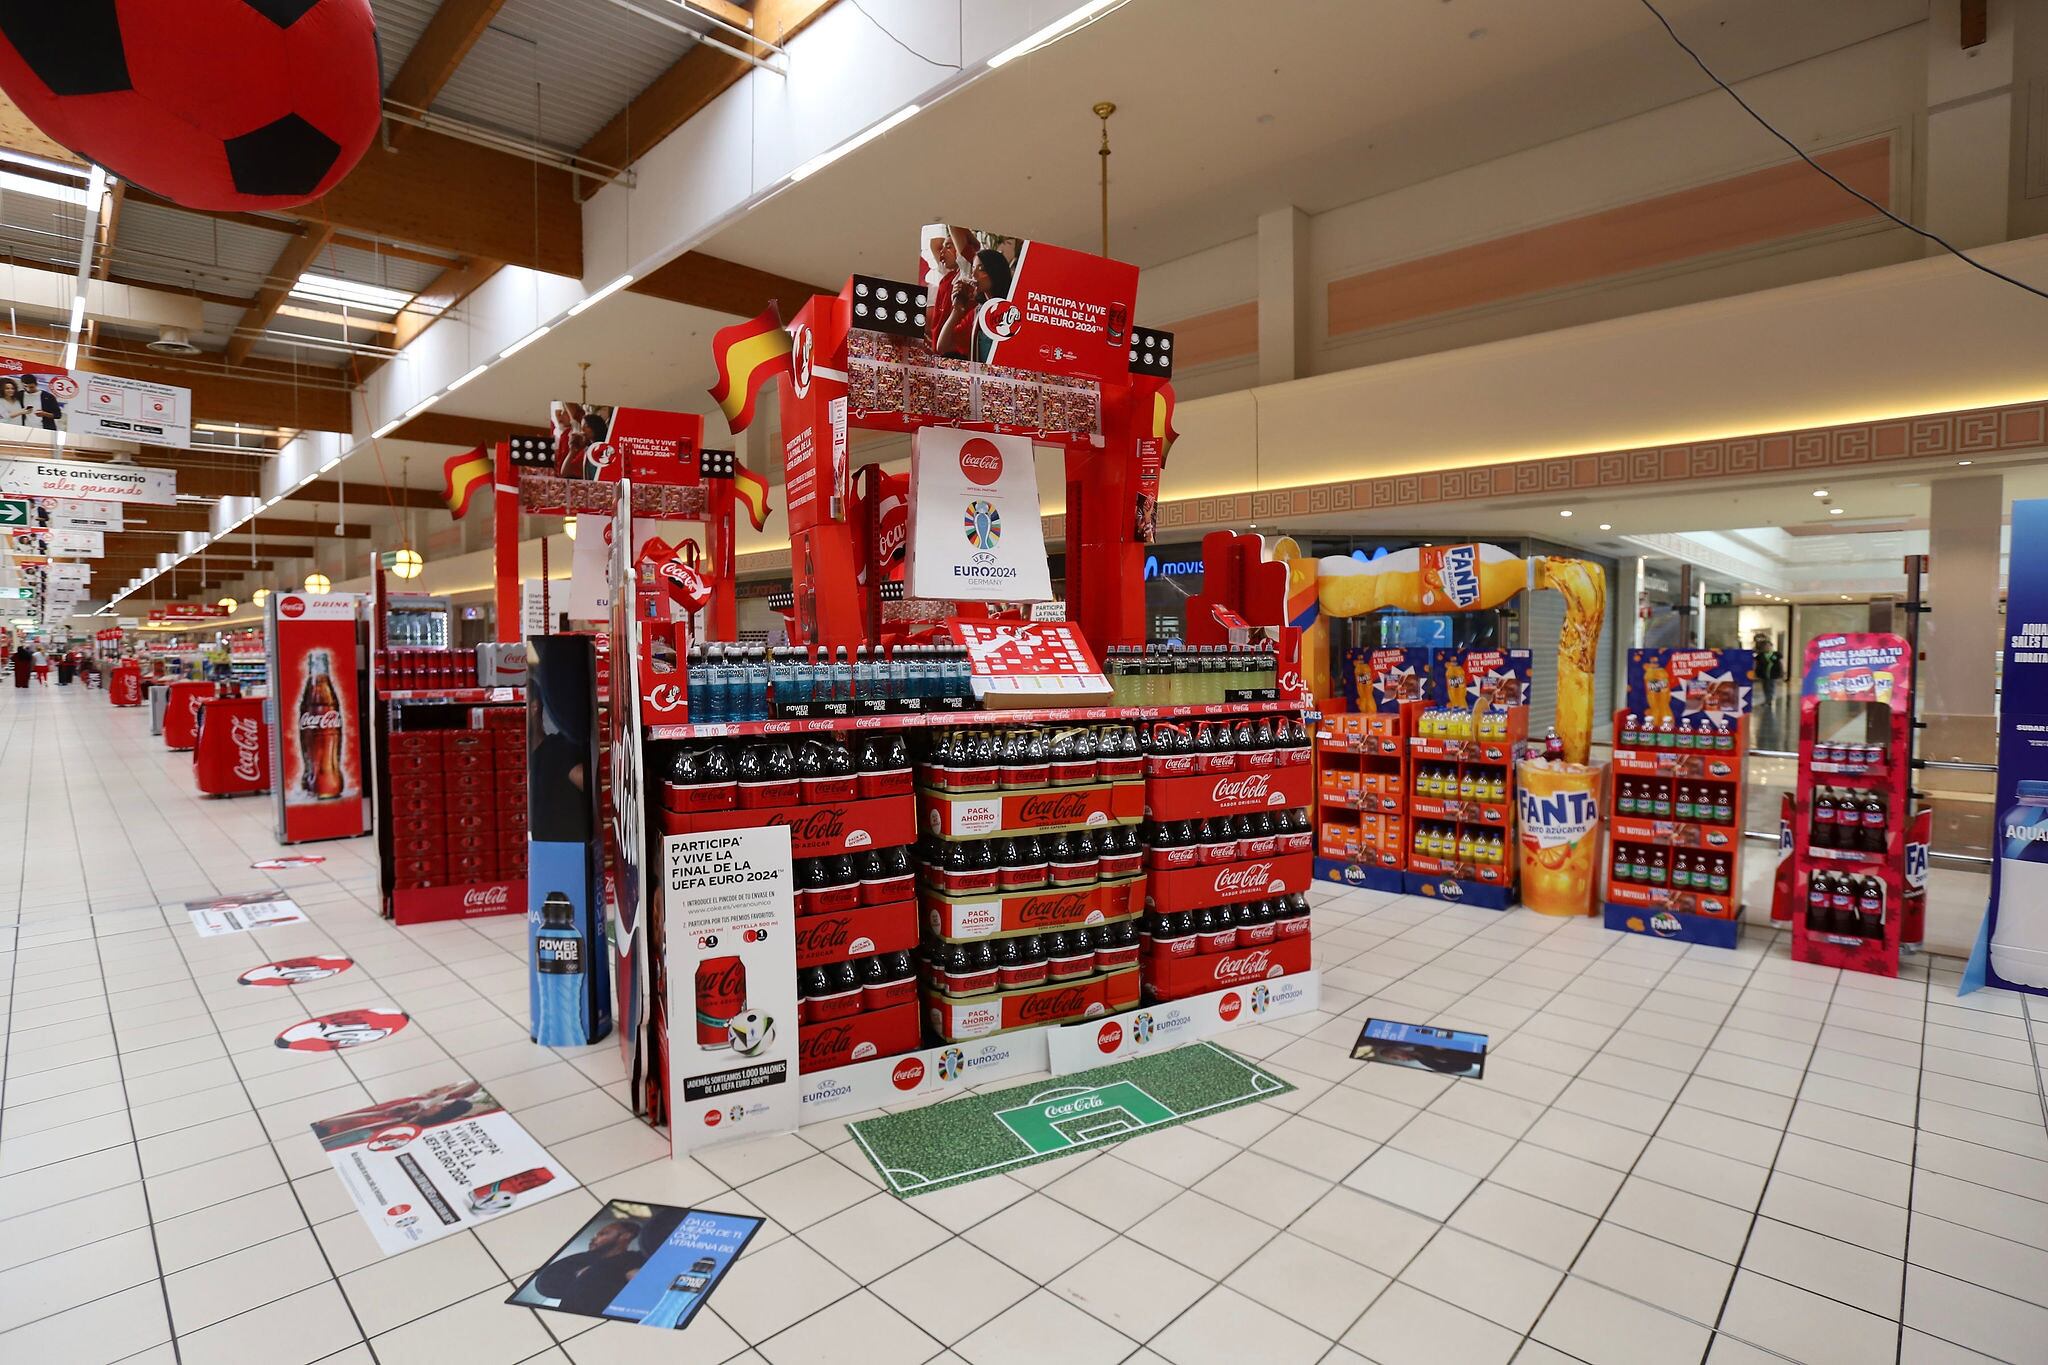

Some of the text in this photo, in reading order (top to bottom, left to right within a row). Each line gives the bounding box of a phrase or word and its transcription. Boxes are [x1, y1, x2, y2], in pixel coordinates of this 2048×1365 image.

[1028, 292, 1106, 315] PARTICIPA Y VIVE
[1027, 302, 1096, 323] LA FINAL DE LA
[1026, 313, 1049, 324] UEFA
[1050, 317, 1075, 329] EURO
[619, 436, 654, 444] PARTICIPA
[962, 453, 999, 470] Coca-Cola
[37, 465, 147, 484] Este aniversario
[43, 478, 143, 498] sales ganando
[973, 554, 995, 564] UEFA
[968, 578, 1003, 586] GERMANY
[1451, 546, 1478, 606] FANTA
[1433, 620, 1446, 639] 2
[1818, 637, 1846, 648] NUEVO
[2012, 636, 2040, 648] SALES
[1820, 651, 1847, 659] AÑADE
[1848, 649, 1878, 658] SABOR
[1820, 659, 1847, 667] SNACK
[1869, 656, 1897, 664] FANTA
[300, 711, 342, 731] Coca-Cola
[2016, 724, 2045, 732] SUDAR
[231, 716, 260, 781] Coca-Cola
[1486, 750, 1502, 758] FANTA
[1165, 758, 1191, 769] Coca-Cola
[1211, 755, 1235, 766] Coca-Cola
[1250, 753, 1274, 764] Coca-Cola
[1213, 774, 1272, 802] Coca-Cola
[967, 807, 989, 815] PACK
[1020, 792, 1089, 822] Coca-Cola
[1519, 788, 1597, 827] FANTA
[961, 814, 995, 822] AHORRO
[1545, 824, 1586, 834] azúcares
[672, 850, 733, 865] Y VIVE LA
[672, 860, 751, 878] FINAL DE LA
[1345, 871, 1366, 880] FANTA
[672, 878, 706, 890] UEFA
[709, 874, 744, 886] EURO
[1214, 863, 1273, 892] Coca-Cola
[464, 886, 508, 906] Coca-Cola
[1440, 884, 1463, 896] FANTA
[687, 897, 712, 907] INTRODUCE
[752, 891, 768, 899] ENVASE
[968, 910, 989, 918] PACK
[1020, 893, 1088, 923] Coca-Cola
[688, 919, 711, 928] PARTICIPA
[731, 914, 750, 922] PREMIOS
[962, 916, 995, 925] AHORRO
[1651, 917, 1682, 932] FANTA
[539, 940, 577, 951] POWER
[555, 950, 578, 961] ADE
[1214, 949, 1273, 980] Coca-Cola
[1019, 986, 1088, 1020] Coca-Cola
[1219, 1000, 1241, 1013] Coca-Cola
[962, 1015, 995, 1025] AHORRO
[968, 1009, 989, 1017] PACK
[1098, 1030, 1121, 1045] Coca-Cola
[687, 1063, 785, 1089] ¡ADEMÁS SORTEAMOS 1.000 BALONES
[893, 1066, 925, 1083] Coca-Cola
[705, 1086, 712, 1094] DE
[736, 1079, 750, 1089] EURO
[1045, 1095, 1105, 1118] Coca-Cola
[685, 1218, 716, 1228] DA LO
[674, 1232, 699, 1240] CON
[680, 1225, 714, 1236] MEJOR
[715, 1229, 730, 1238] DE
[669, 1239, 717, 1251] VITAMINA
